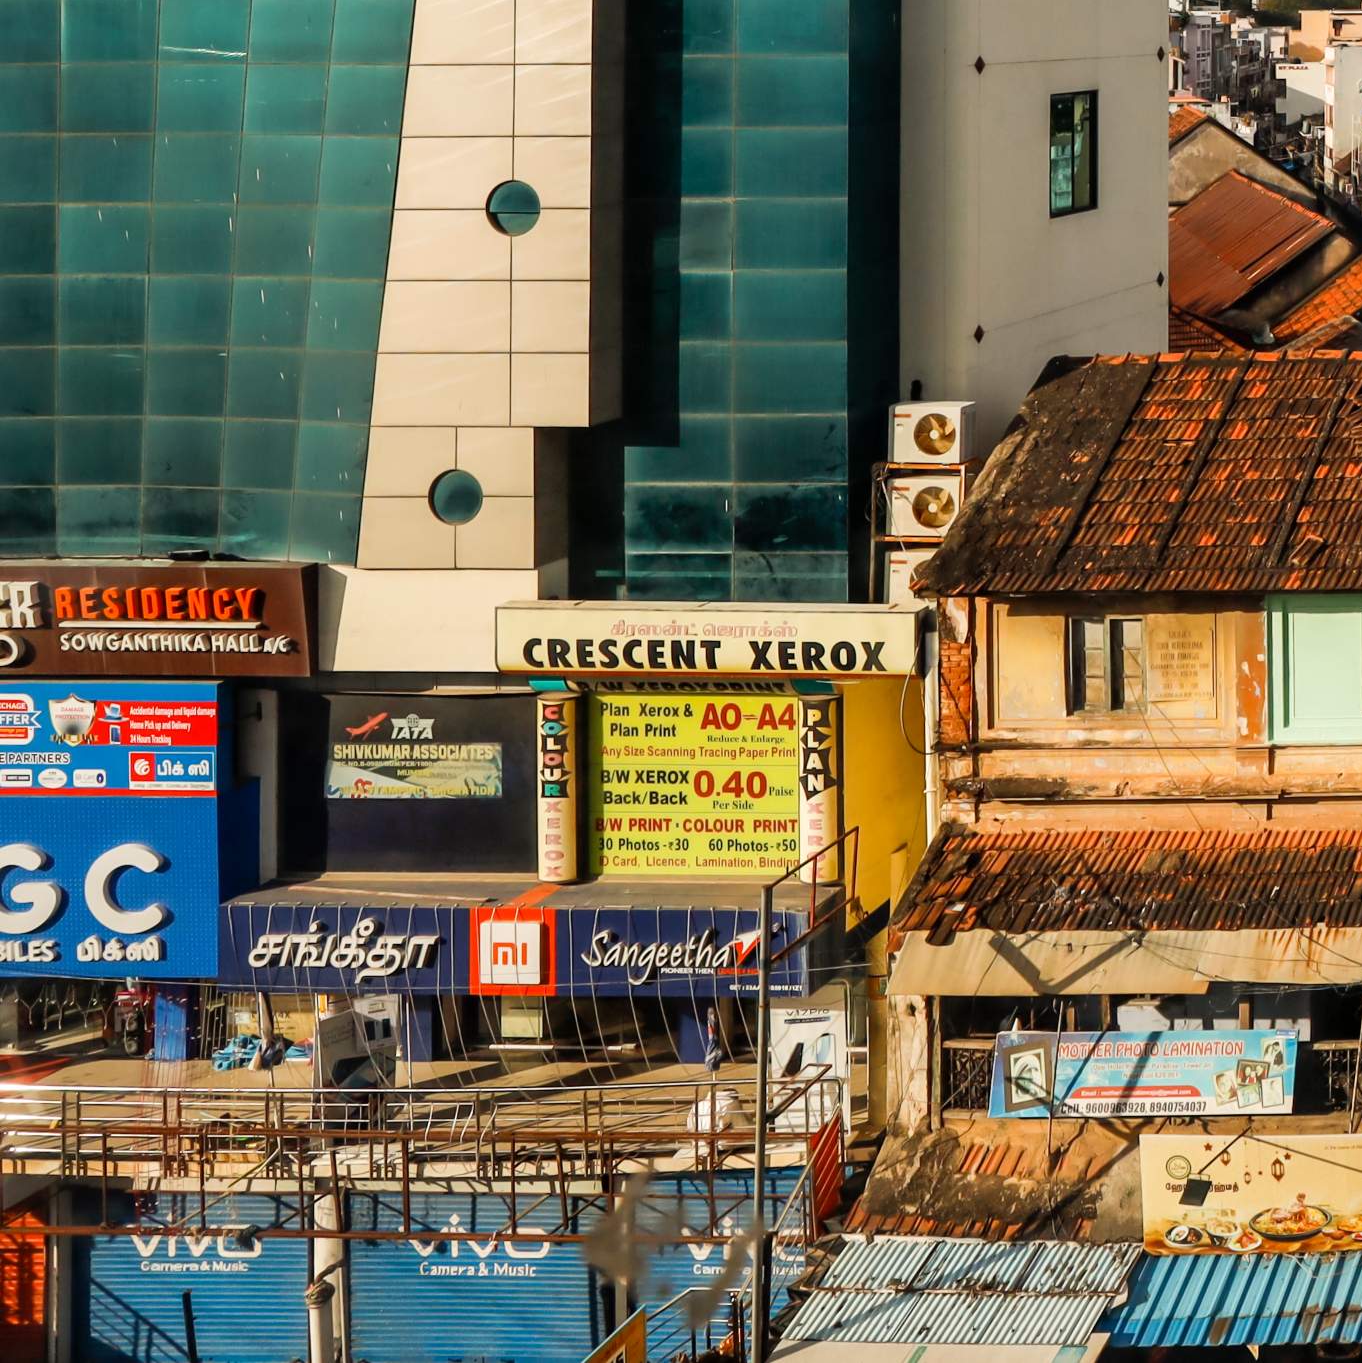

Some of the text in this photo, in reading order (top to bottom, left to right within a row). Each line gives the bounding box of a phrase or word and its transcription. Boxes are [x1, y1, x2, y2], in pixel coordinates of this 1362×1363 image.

[55, 586, 263, 621] RESIDENCY
[60, 632, 208, 653] SOWGANTHIKA
[211, 634, 262, 653] HALL
[522, 637, 888, 672] CRESCENT XEROX
[600, 703, 694, 717] Plan Xerox &
[391, 725, 434, 740] IATA
[609, 723, 677, 737] Plan Print
[707, 735, 739, 743] Reduce
[750, 735, 785, 744] Enlarge
[9, 752, 70, 764] PARTNERS
[333, 744, 494, 760] SHIVKUMAR ASSOCIATES
[602, 746, 796, 759] Any Size Scanning Tracing Paper Print
[600, 770, 690, 784] B/W XEROX
[693, 769, 794, 799] 0.40 Paise
[603, 790, 688, 806] Back/Back
[712, 800, 754, 811] Per Side
[628, 818, 672, 833] PRINT
[682, 819, 798, 833] COLOUR PRINT
[618, 838, 660, 852] Photos
[708, 838, 723, 852] 60
[727, 839, 769, 853] Photos
[758, 857, 800, 870] Binding
[247, 915, 442, 984] சங்கீதா
[580, 927, 738, 986] Sangeetha
[1058, 1040, 1245, 1059] MOTHER PHOTO LAMINATION
[1149, 1100, 1207, 1113] 8940754037
[140, 1260, 249, 1272] Camera & Music
[419, 1261, 537, 1277] Camera & Music
